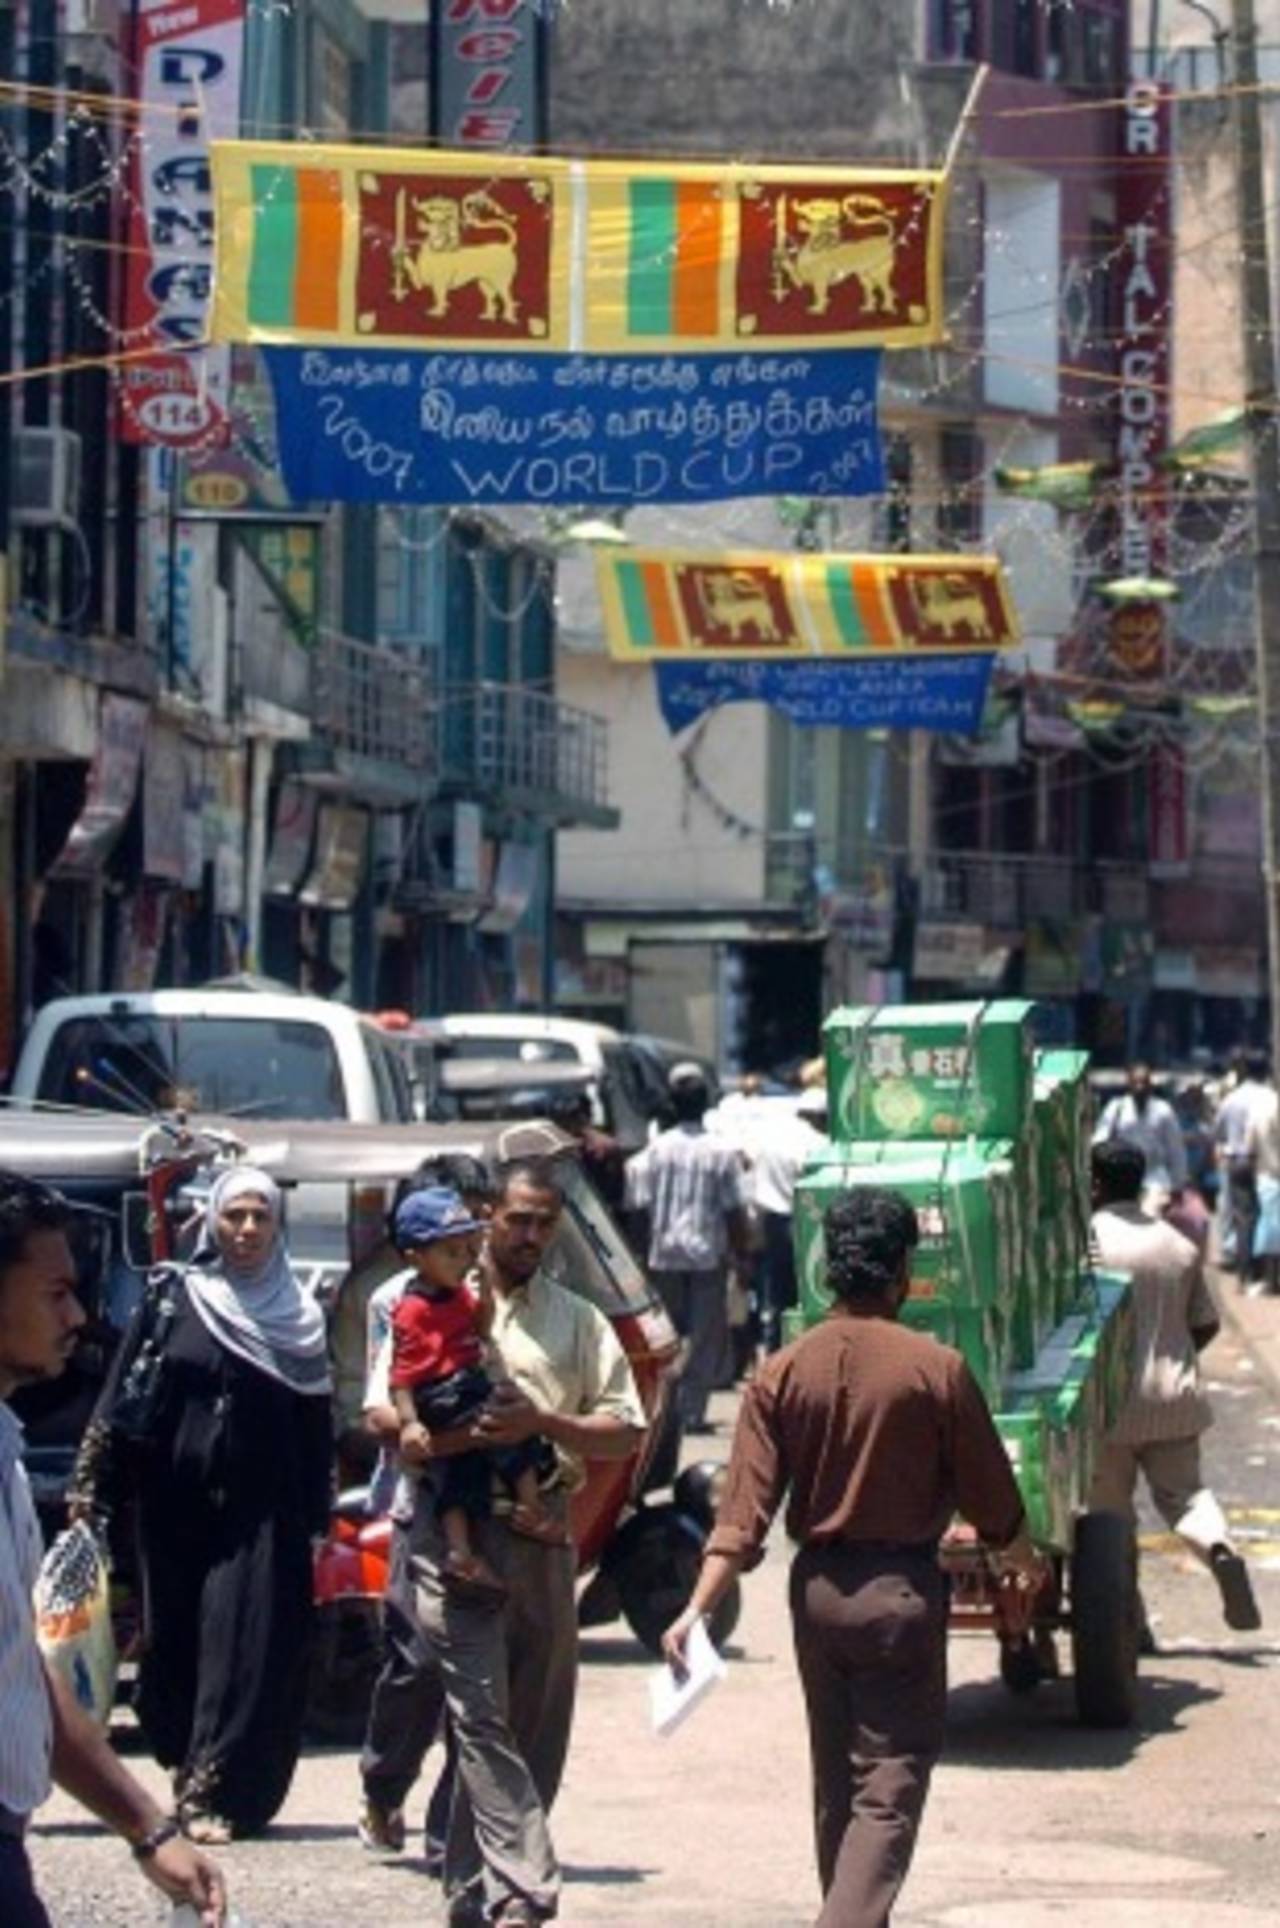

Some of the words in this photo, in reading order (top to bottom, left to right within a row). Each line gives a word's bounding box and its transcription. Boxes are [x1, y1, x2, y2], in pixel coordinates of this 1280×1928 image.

[149, 402, 203, 426] 114
[450, 449, 671, 497] WORLD
[681, 441, 804, 490] CUP
